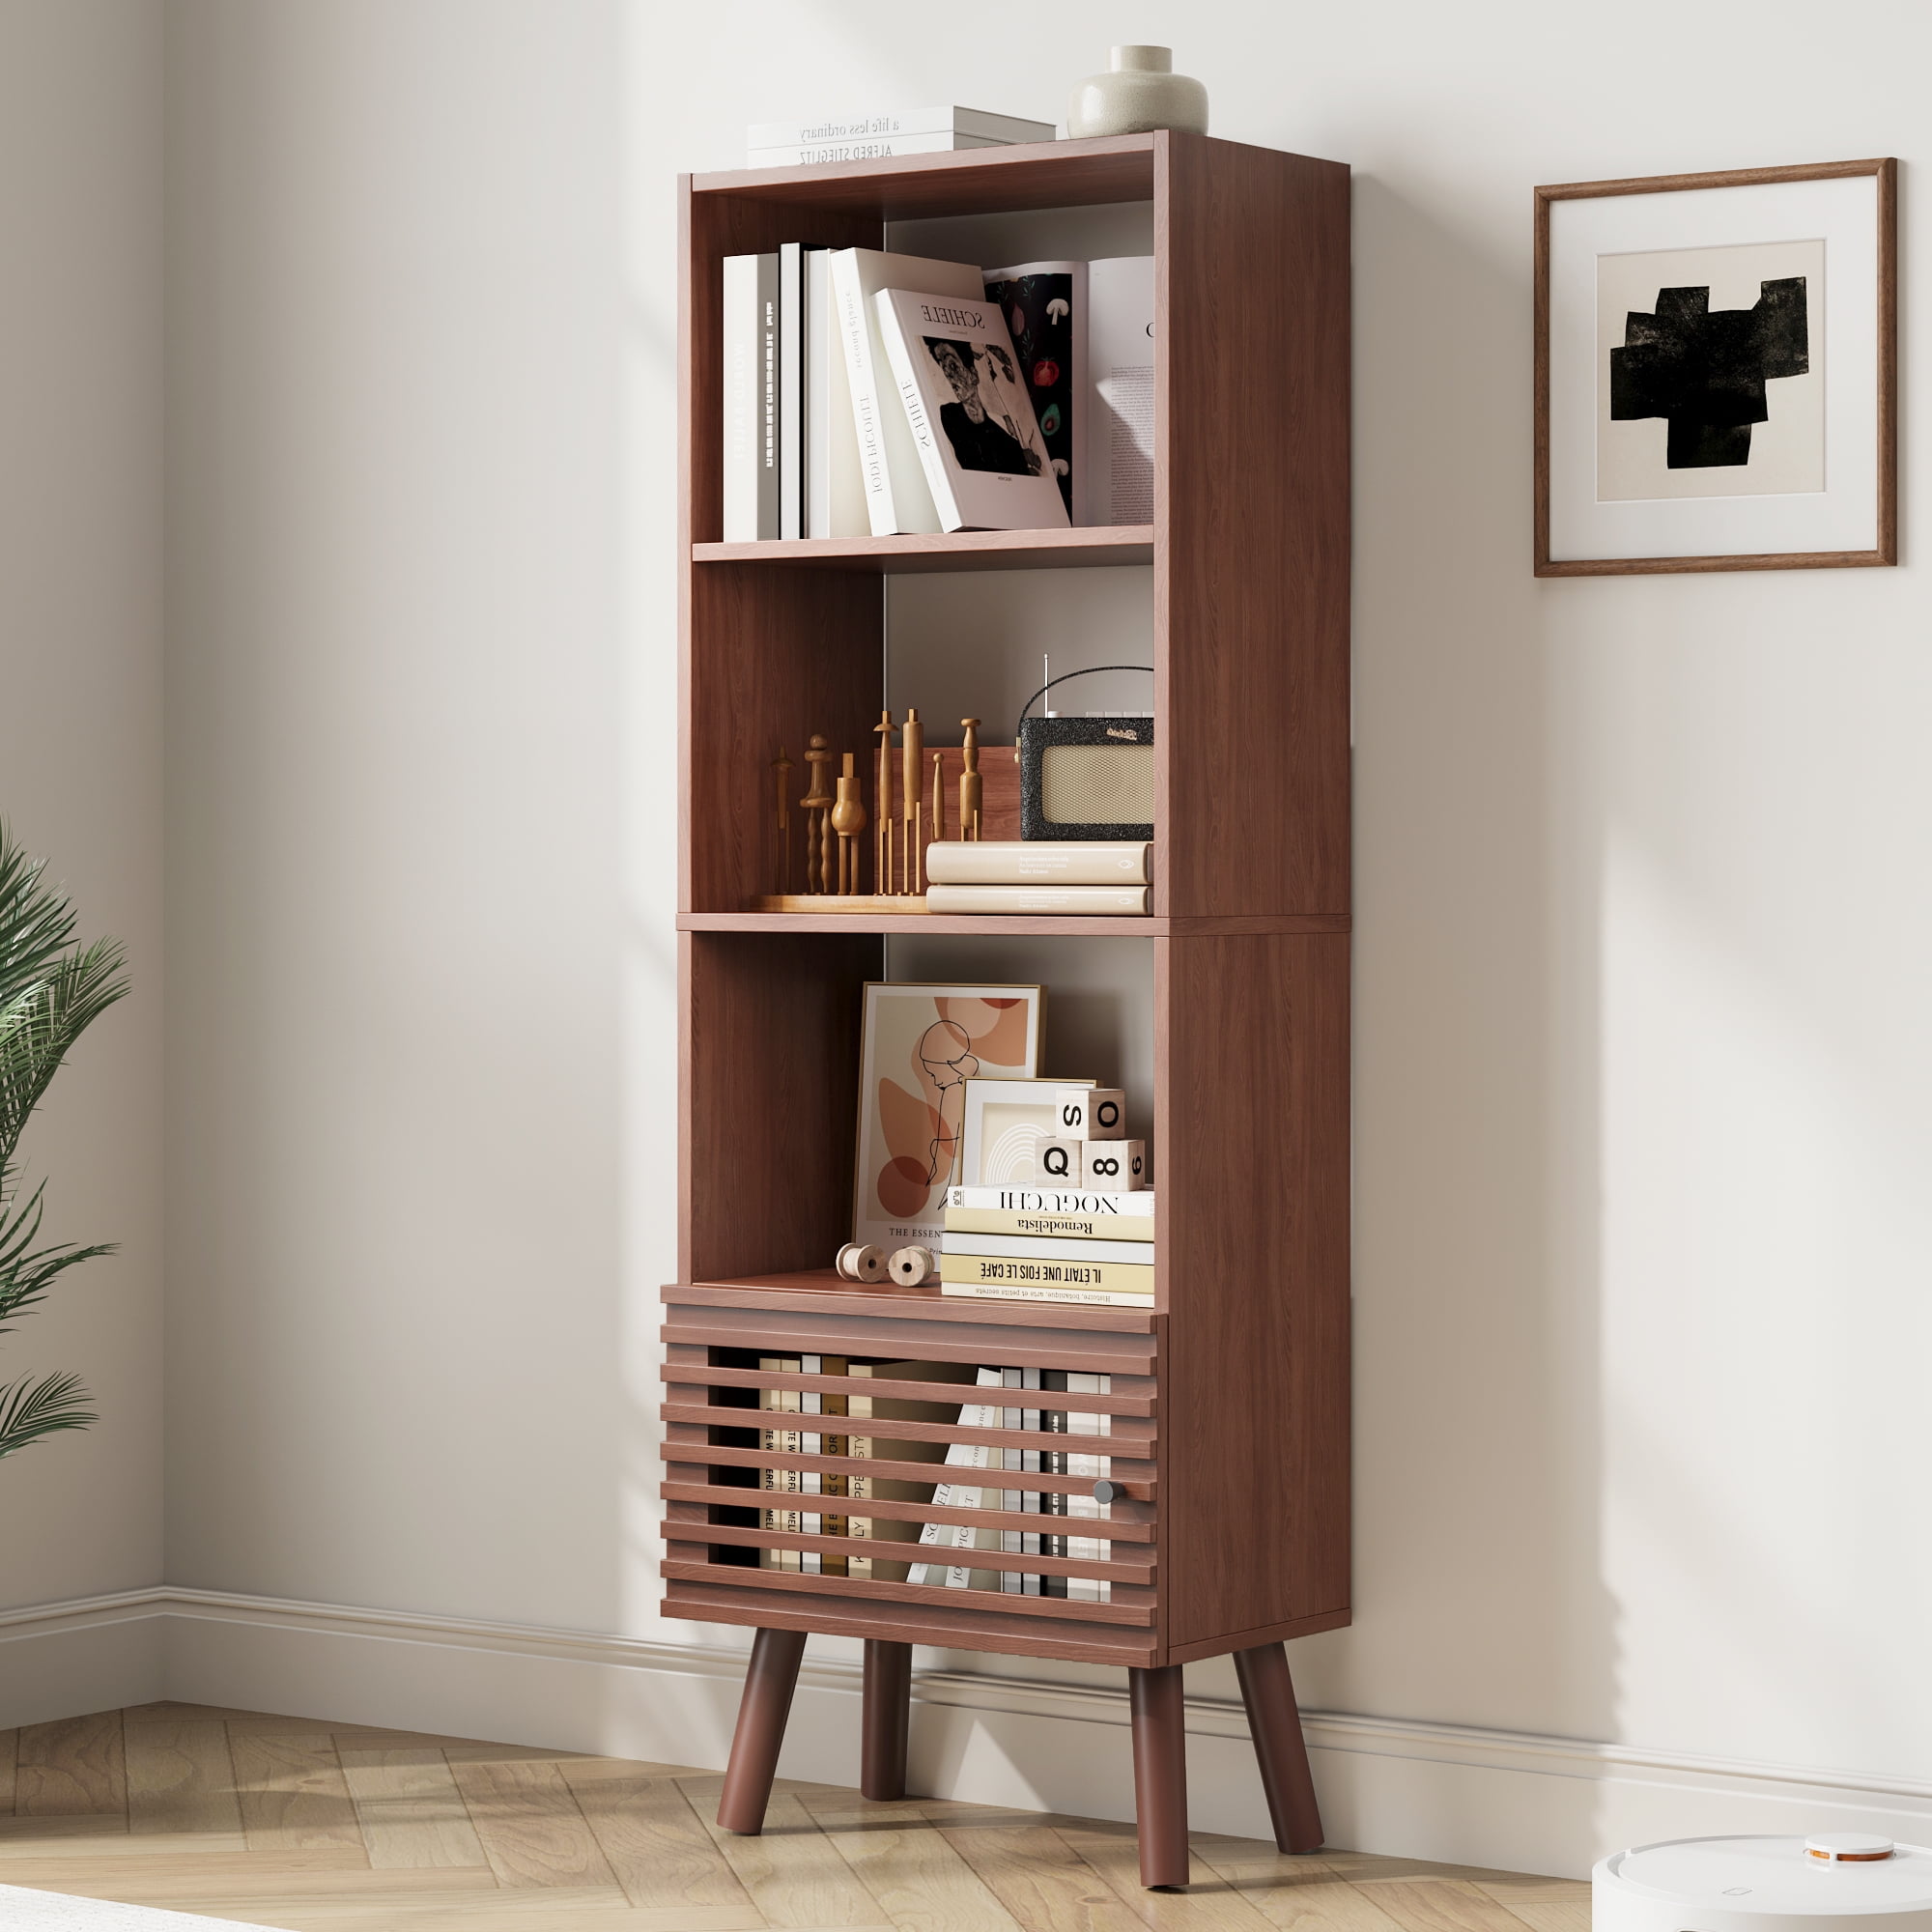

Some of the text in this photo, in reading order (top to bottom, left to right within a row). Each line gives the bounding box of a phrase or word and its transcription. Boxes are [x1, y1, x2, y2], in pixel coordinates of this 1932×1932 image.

[1063, 1100, 1119, 1128] S O
[1043, 1147, 1068, 1178] Q
[1093, 1157, 1120, 1177] 8
[1000, 1191, 1119, 1214] NOGUCHI
[889, 1228, 943, 1237] THE ESSEN
[1017, 1219, 1093, 1235] Remodelista
[980, 1263, 1101, 1286] IL ÉTAIT UNE FOIS LE CAFÉ
